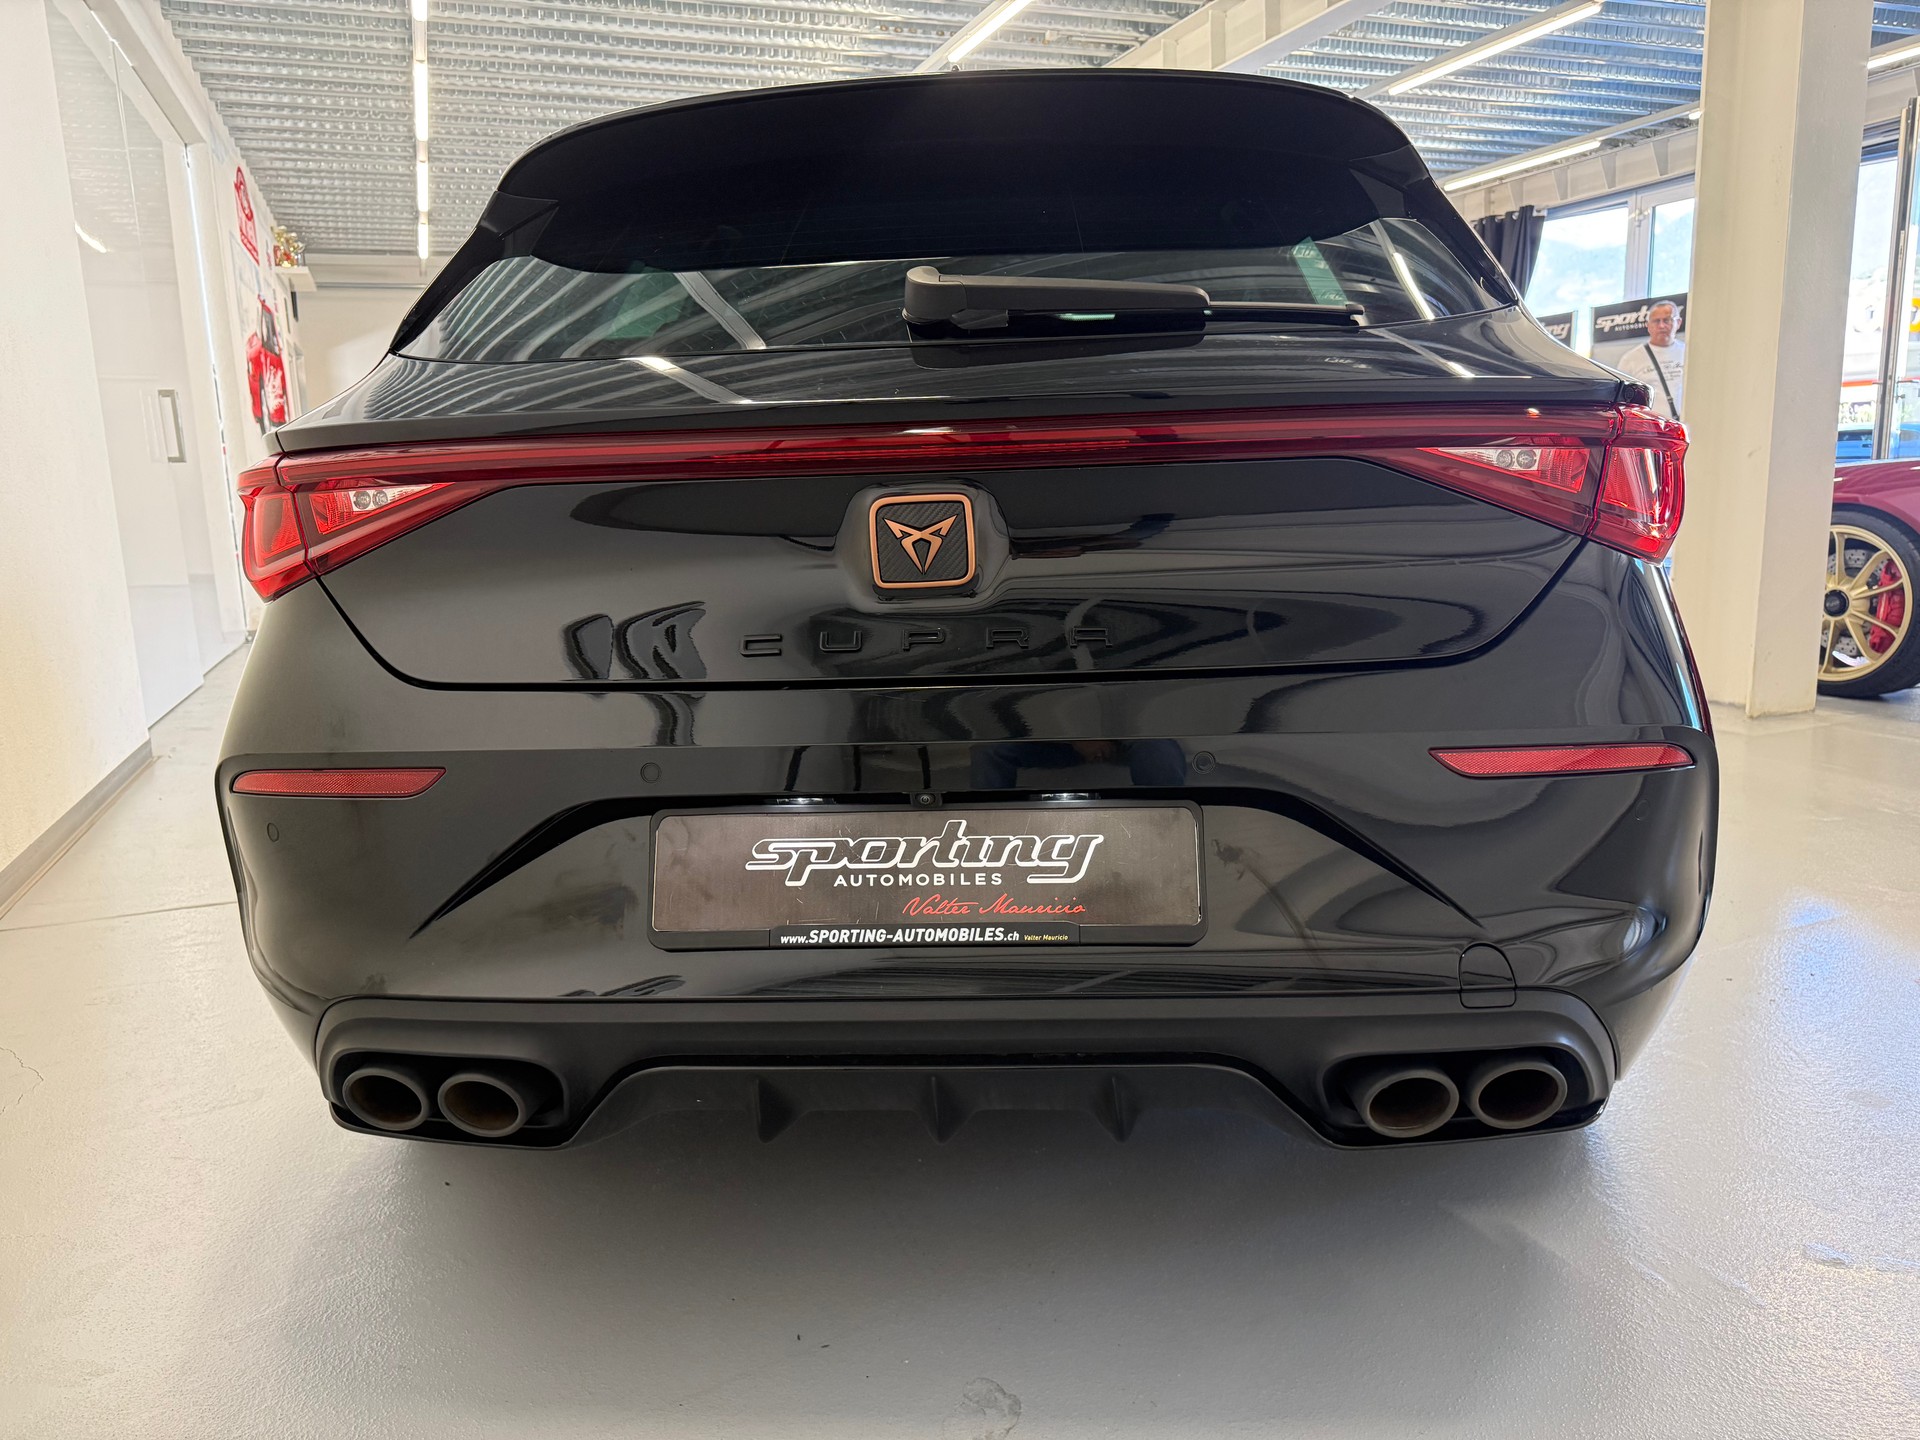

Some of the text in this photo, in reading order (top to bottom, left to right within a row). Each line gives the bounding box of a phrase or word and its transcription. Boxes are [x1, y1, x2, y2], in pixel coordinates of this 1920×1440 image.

[739, 626, 1113, 656] CUPRA
[745, 819, 1104, 887] sporting
[833, 872, 1003, 887] AUTOMOBILES
[903, 893, 1086, 916] Valter Mauricio
[780, 927, 1019, 944] www.SPORTING-AUTOMOBILES.ch
